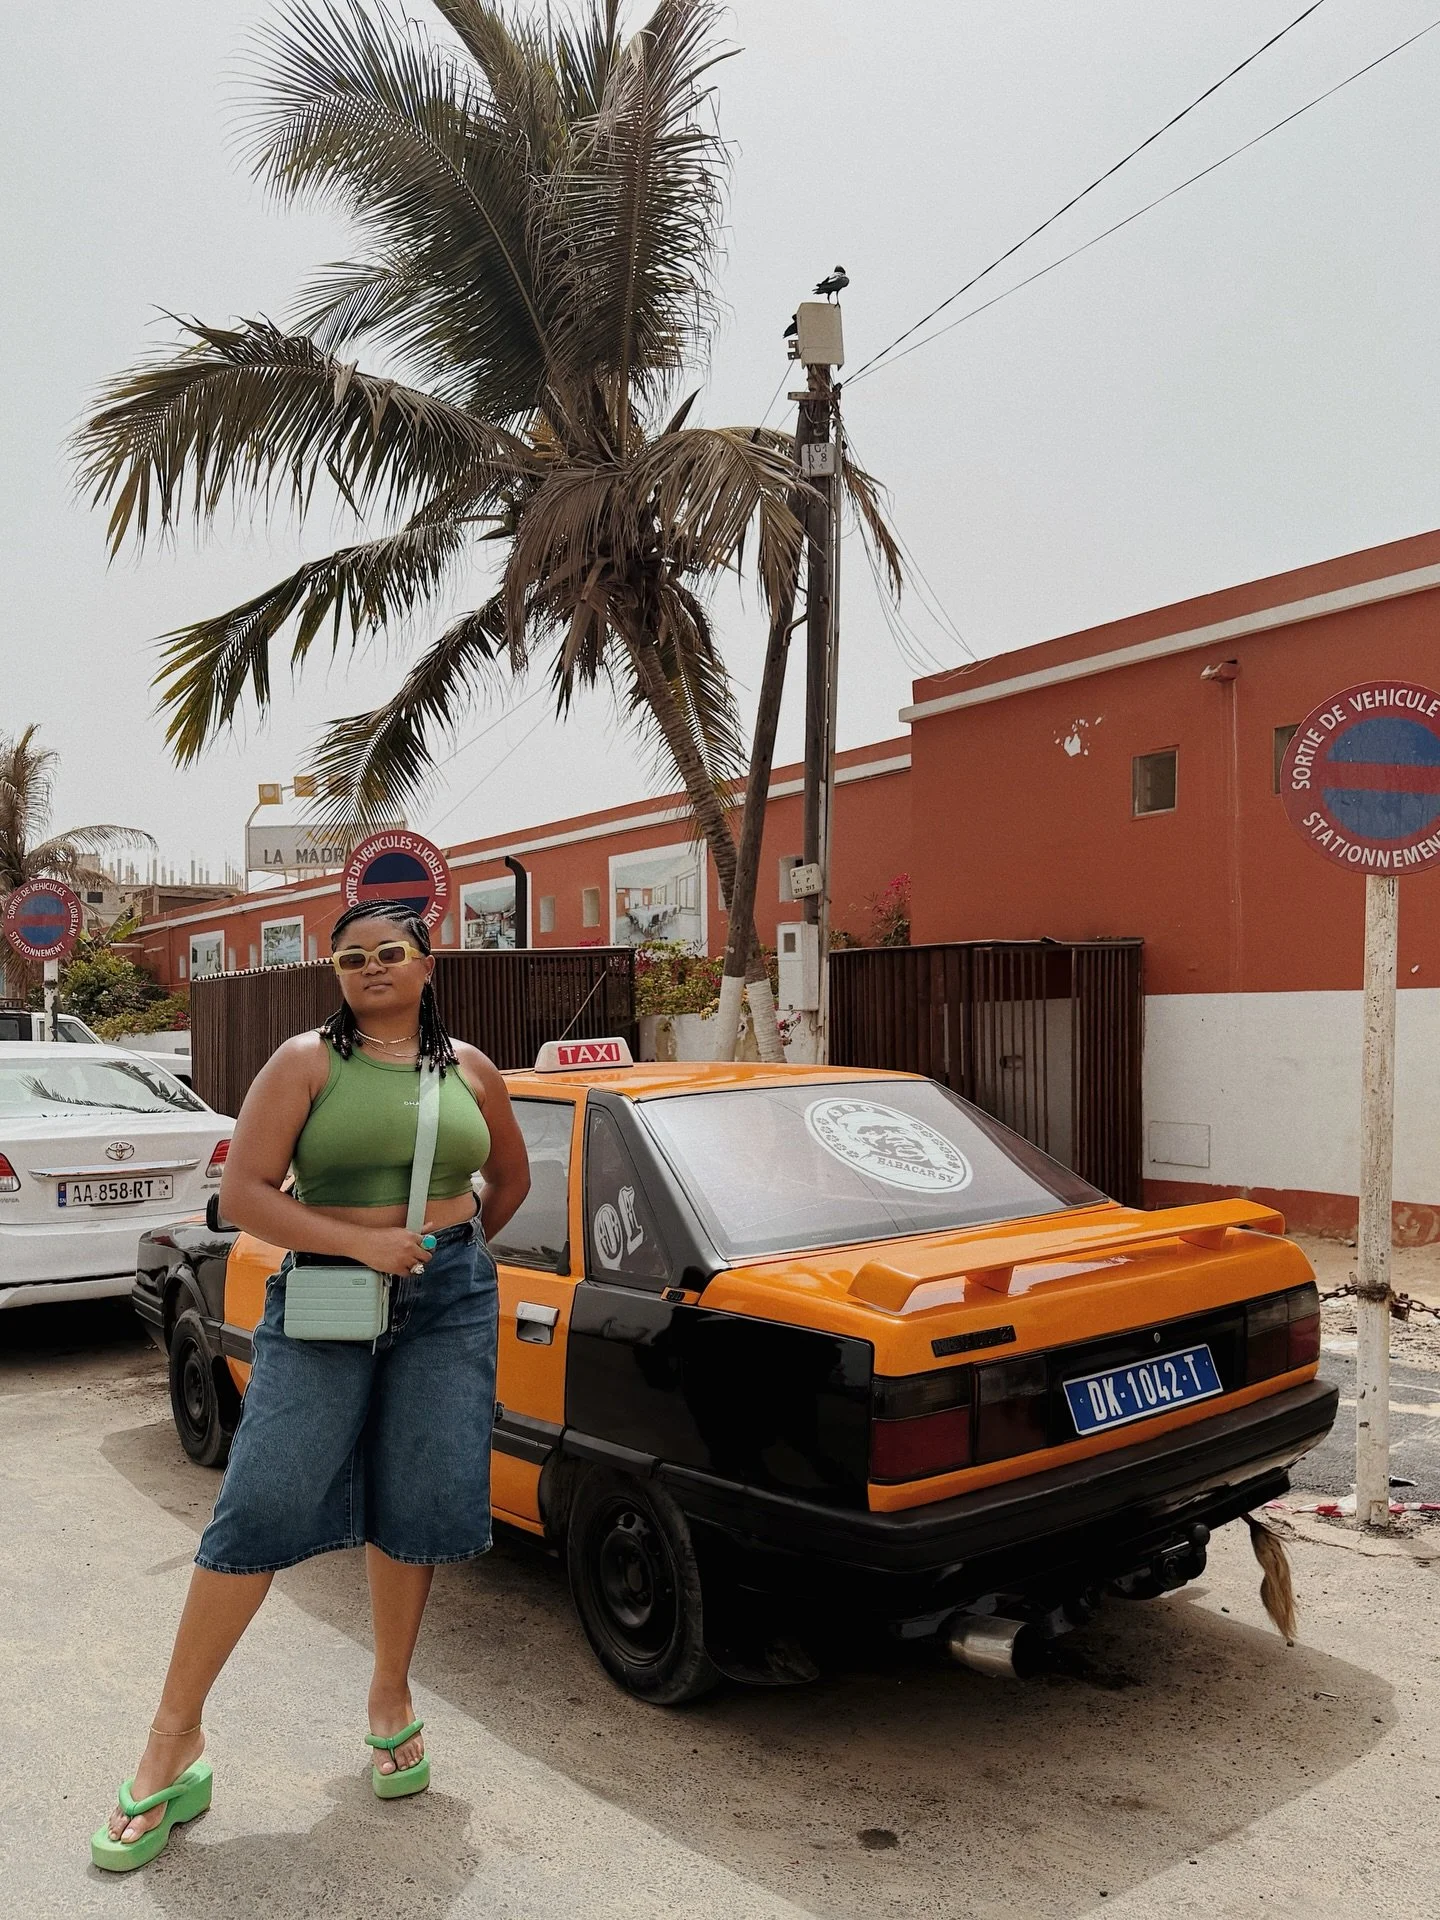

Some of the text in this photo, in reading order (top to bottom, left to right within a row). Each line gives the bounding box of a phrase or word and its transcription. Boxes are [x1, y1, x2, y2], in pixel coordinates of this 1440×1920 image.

[1291, 728, 1326, 790] SORTIE
[1319, 704, 1347, 730] DE
[264, 848, 284, 865] LA
[345, 835, 413, 907] ORTIE DE VEHICULES
[413, 842, 448, 896] INTERDIT
[7, 882, 67, 919] SORTIE DE VEHICULES
[67, 900, 79, 937] INTERDIT
[9, 931, 65, 957] STATIONNEMENT
[561, 1044, 618, 1063] TAXI
[938, 1172, 954, 1183] SY
